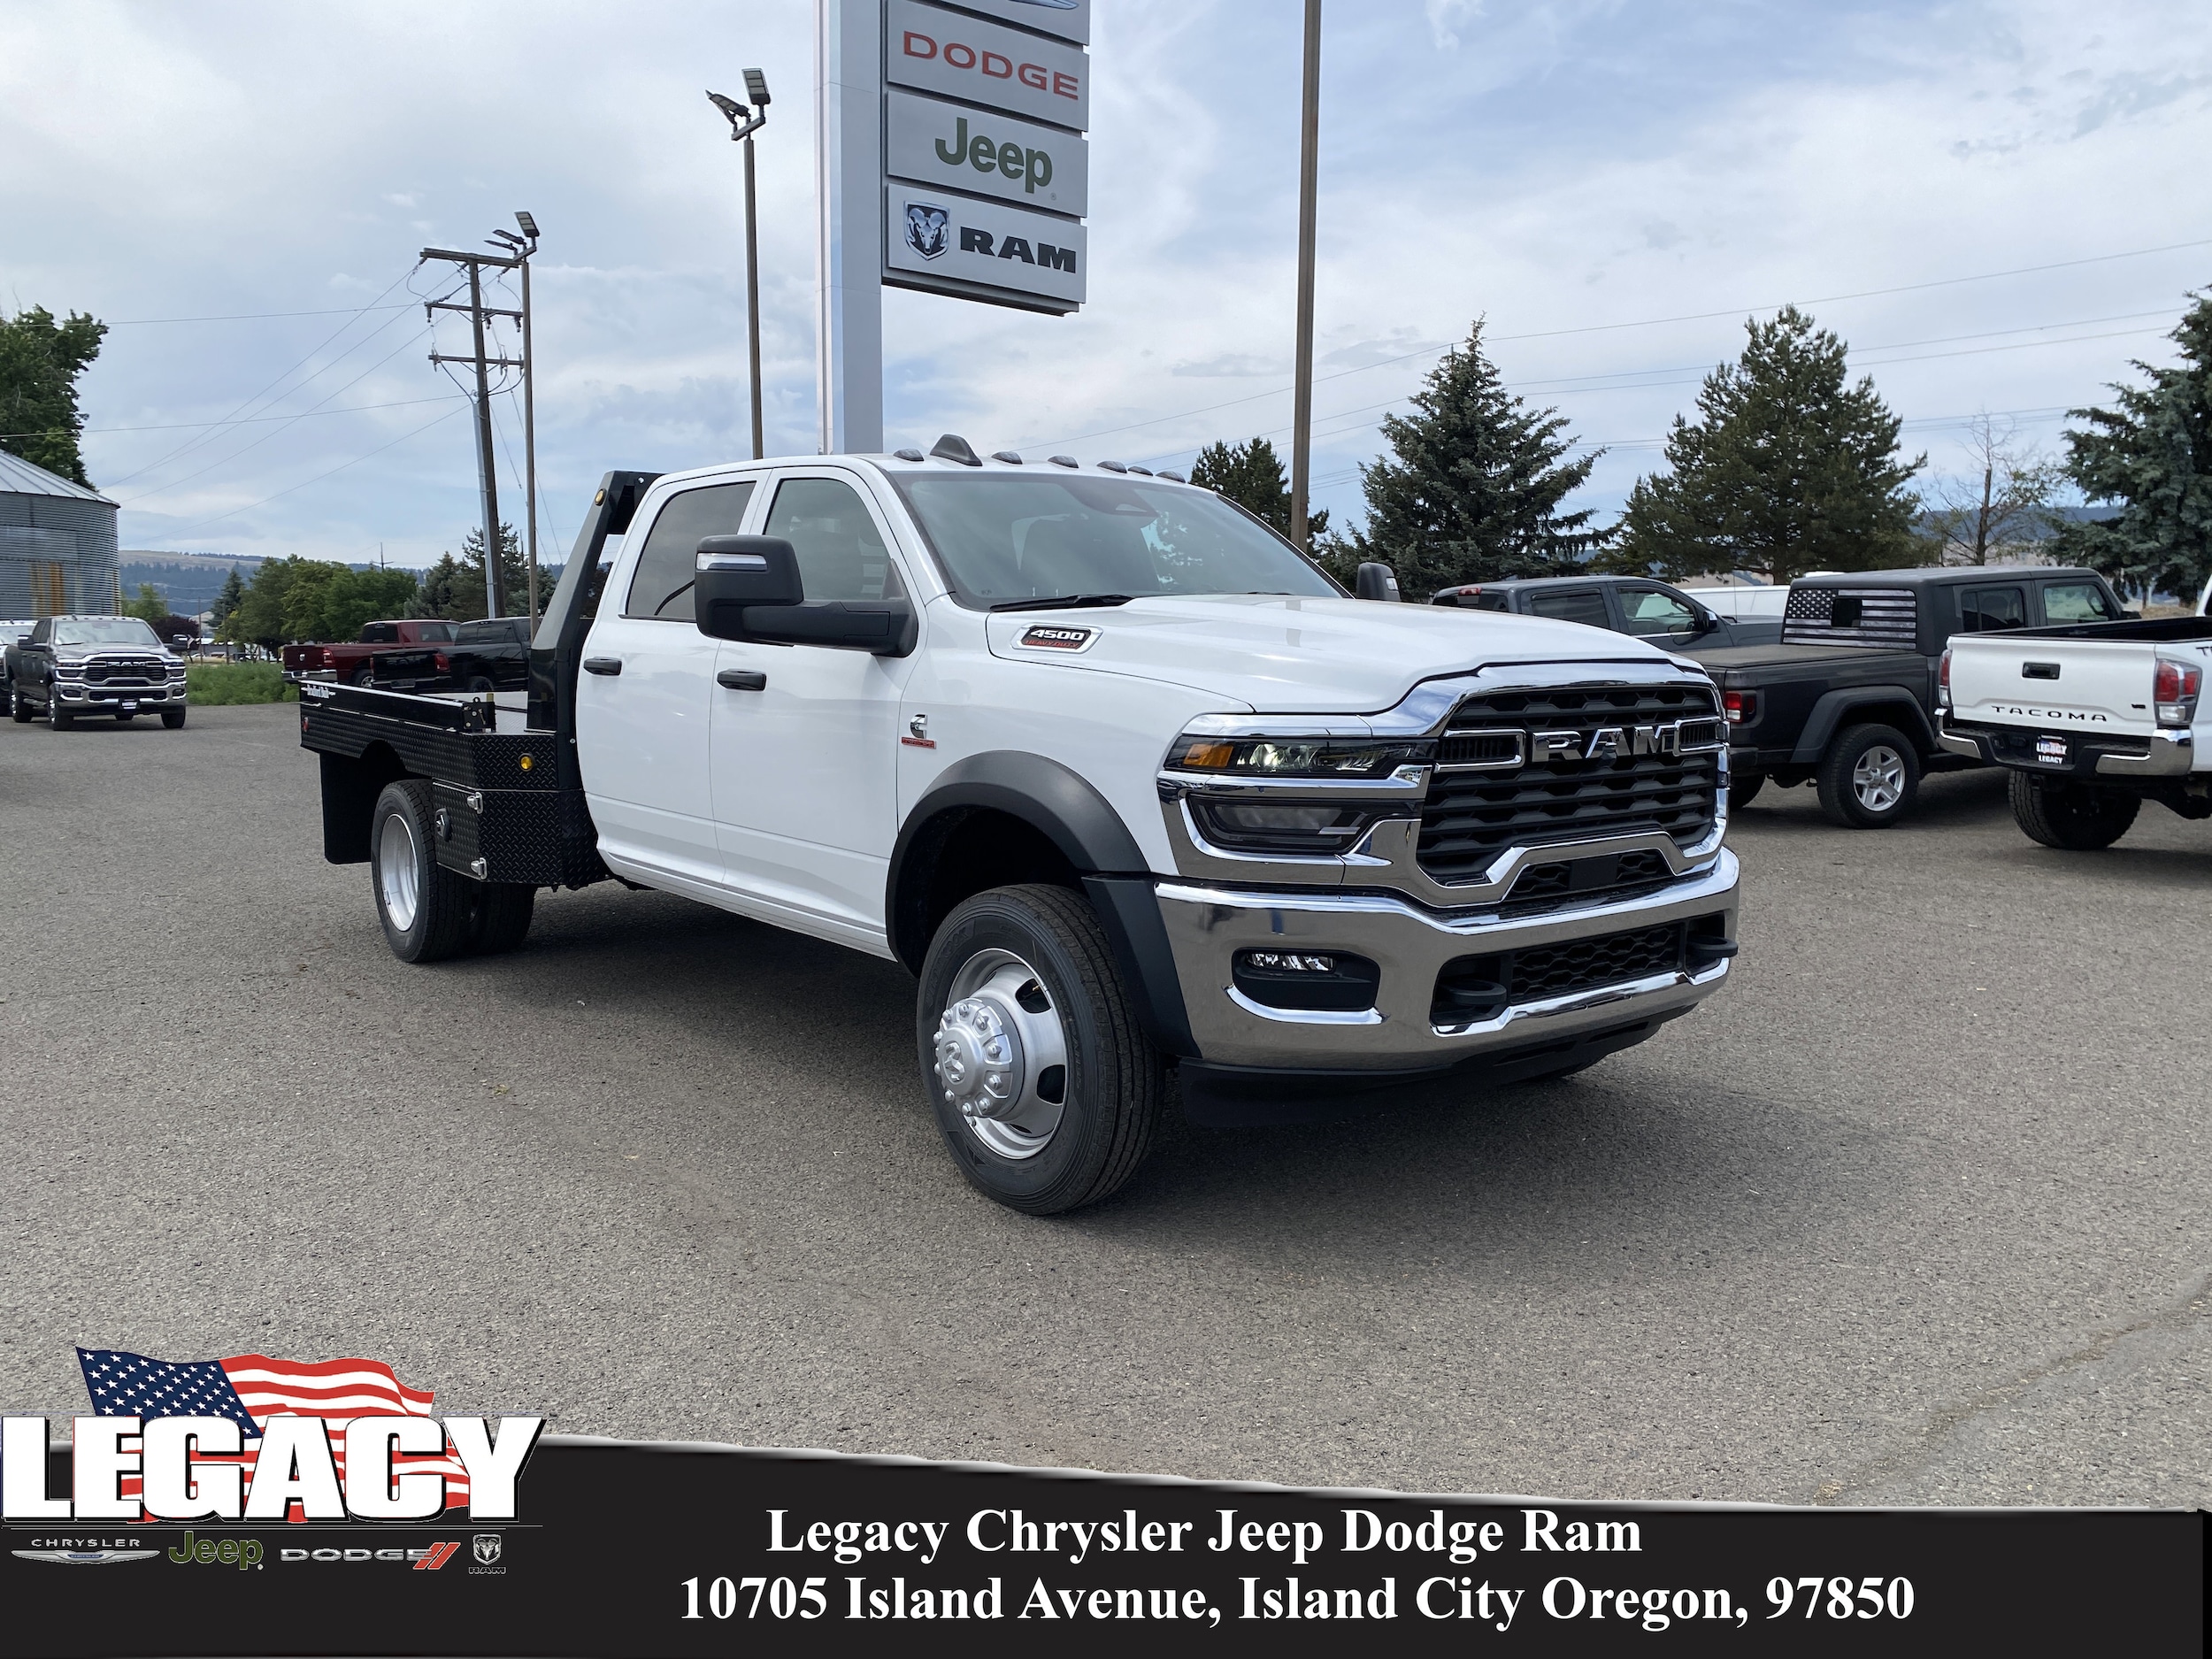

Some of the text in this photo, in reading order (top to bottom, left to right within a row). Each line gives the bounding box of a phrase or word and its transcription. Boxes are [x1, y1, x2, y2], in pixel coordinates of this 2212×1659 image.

[903, 31, 1079, 101] DODGE
[934, 117, 1053, 194] Jeep
[960, 226, 1077, 274] RAM
[1030, 629, 1085, 641] 4500
[1991, 705, 2108, 722] TACOMA
[1532, 726, 1680, 763] RAM
[2038, 754, 2063, 764] LEGACY
